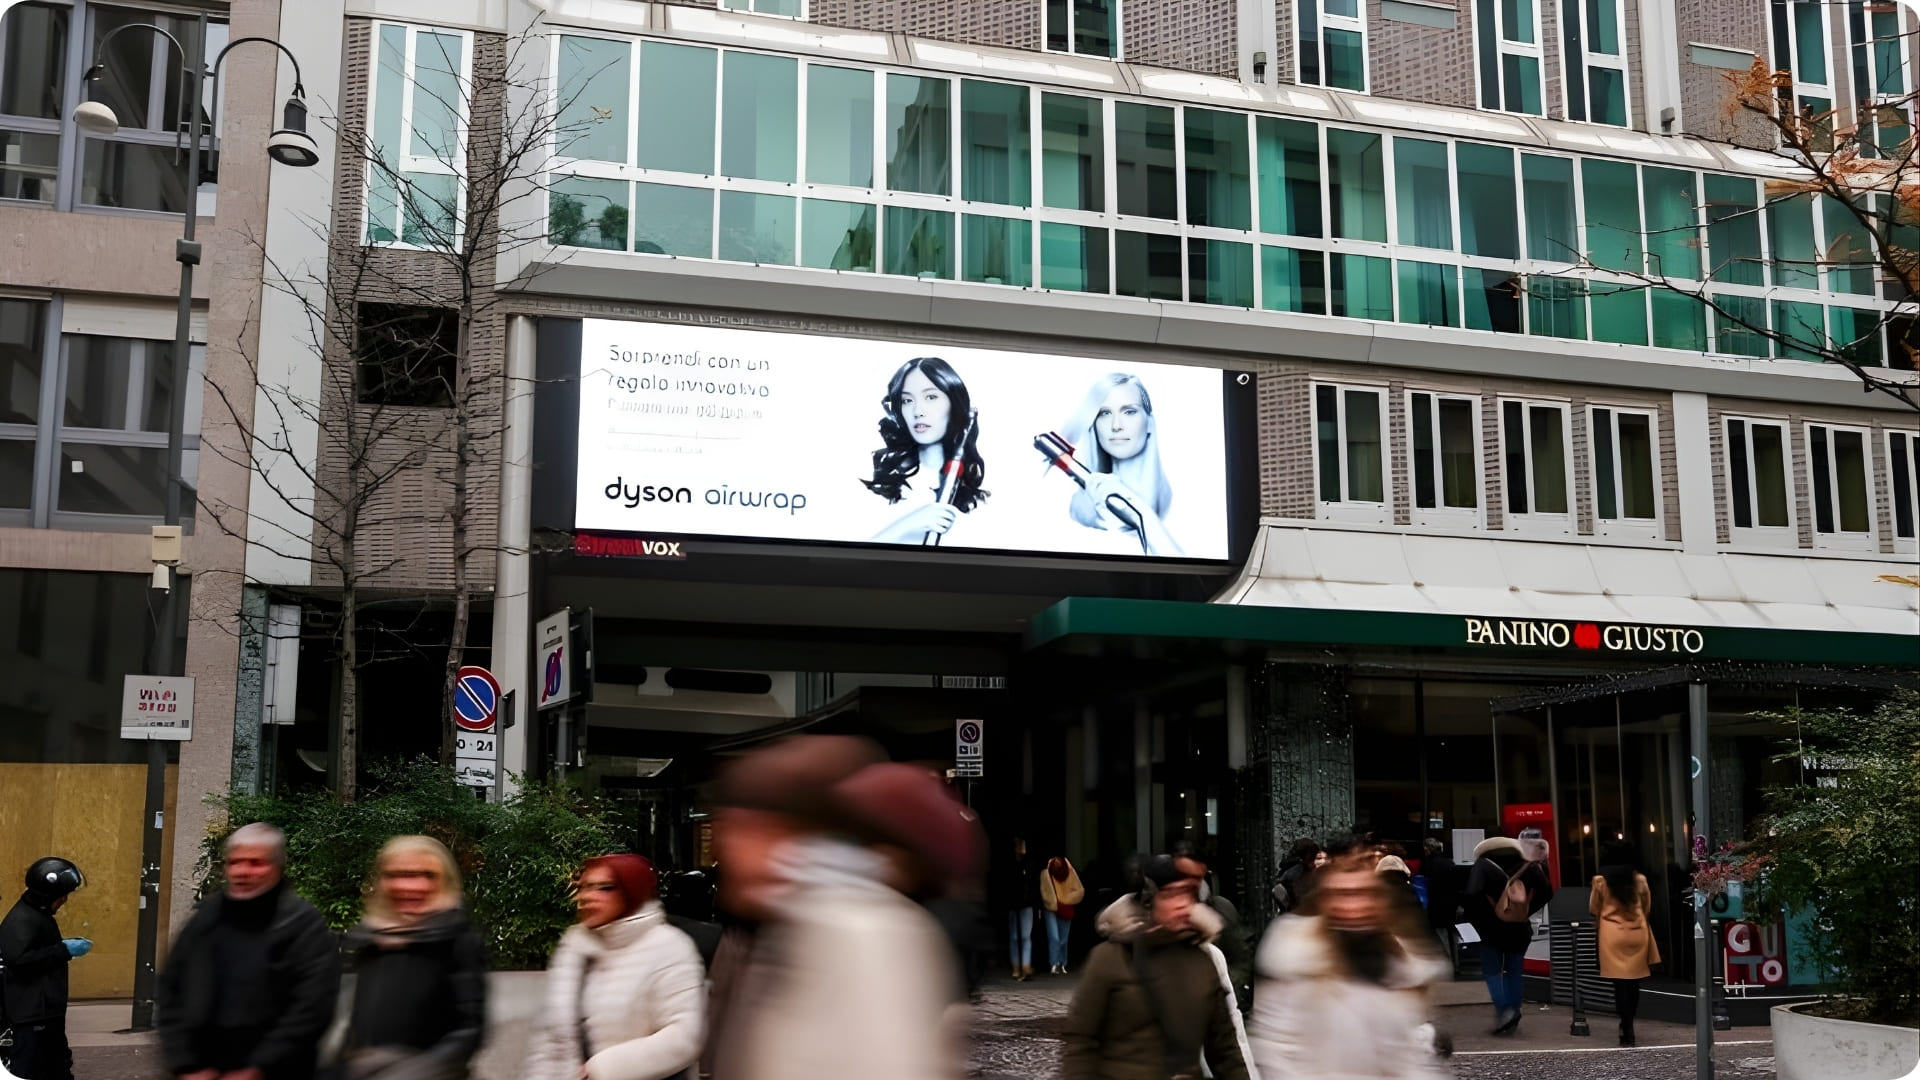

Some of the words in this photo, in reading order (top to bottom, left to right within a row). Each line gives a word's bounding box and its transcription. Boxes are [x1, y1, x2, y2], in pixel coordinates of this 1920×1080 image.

[708, 356, 741, 369] con
[747, 359, 770, 371] un
[604, 476, 692, 508] dyson
[704, 484, 807, 516] airwrap
[1465, 617, 1570, 648] PANINO
[1603, 625, 1704, 653] GIUSTO
[476, 740, 493, 751] 24
